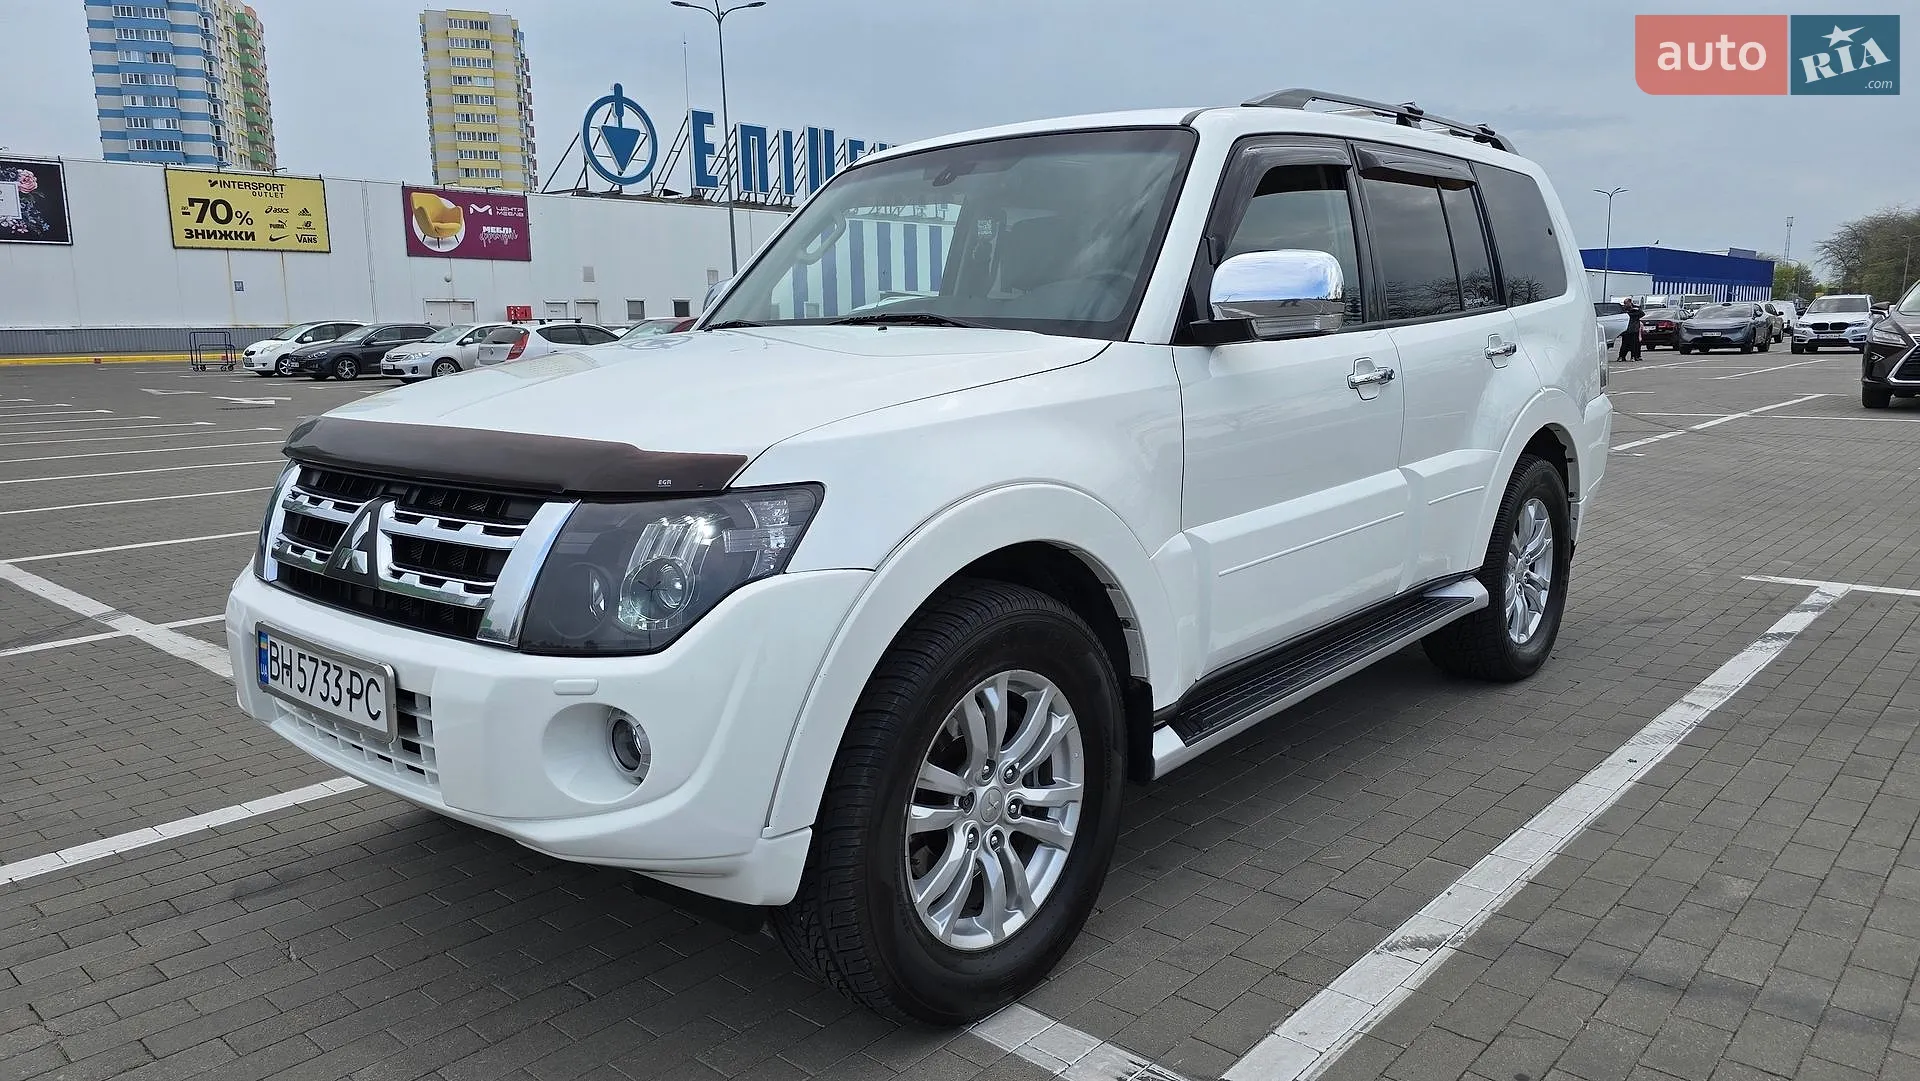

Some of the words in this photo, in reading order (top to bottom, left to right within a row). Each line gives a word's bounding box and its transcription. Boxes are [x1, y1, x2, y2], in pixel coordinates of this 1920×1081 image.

[220, 179, 286, 193] INTERSPORT
[252, 191, 284, 199] OUTLET
[184, 228, 256, 242] ЗНИЖКИ
[260, 663, 268, 675] UA
